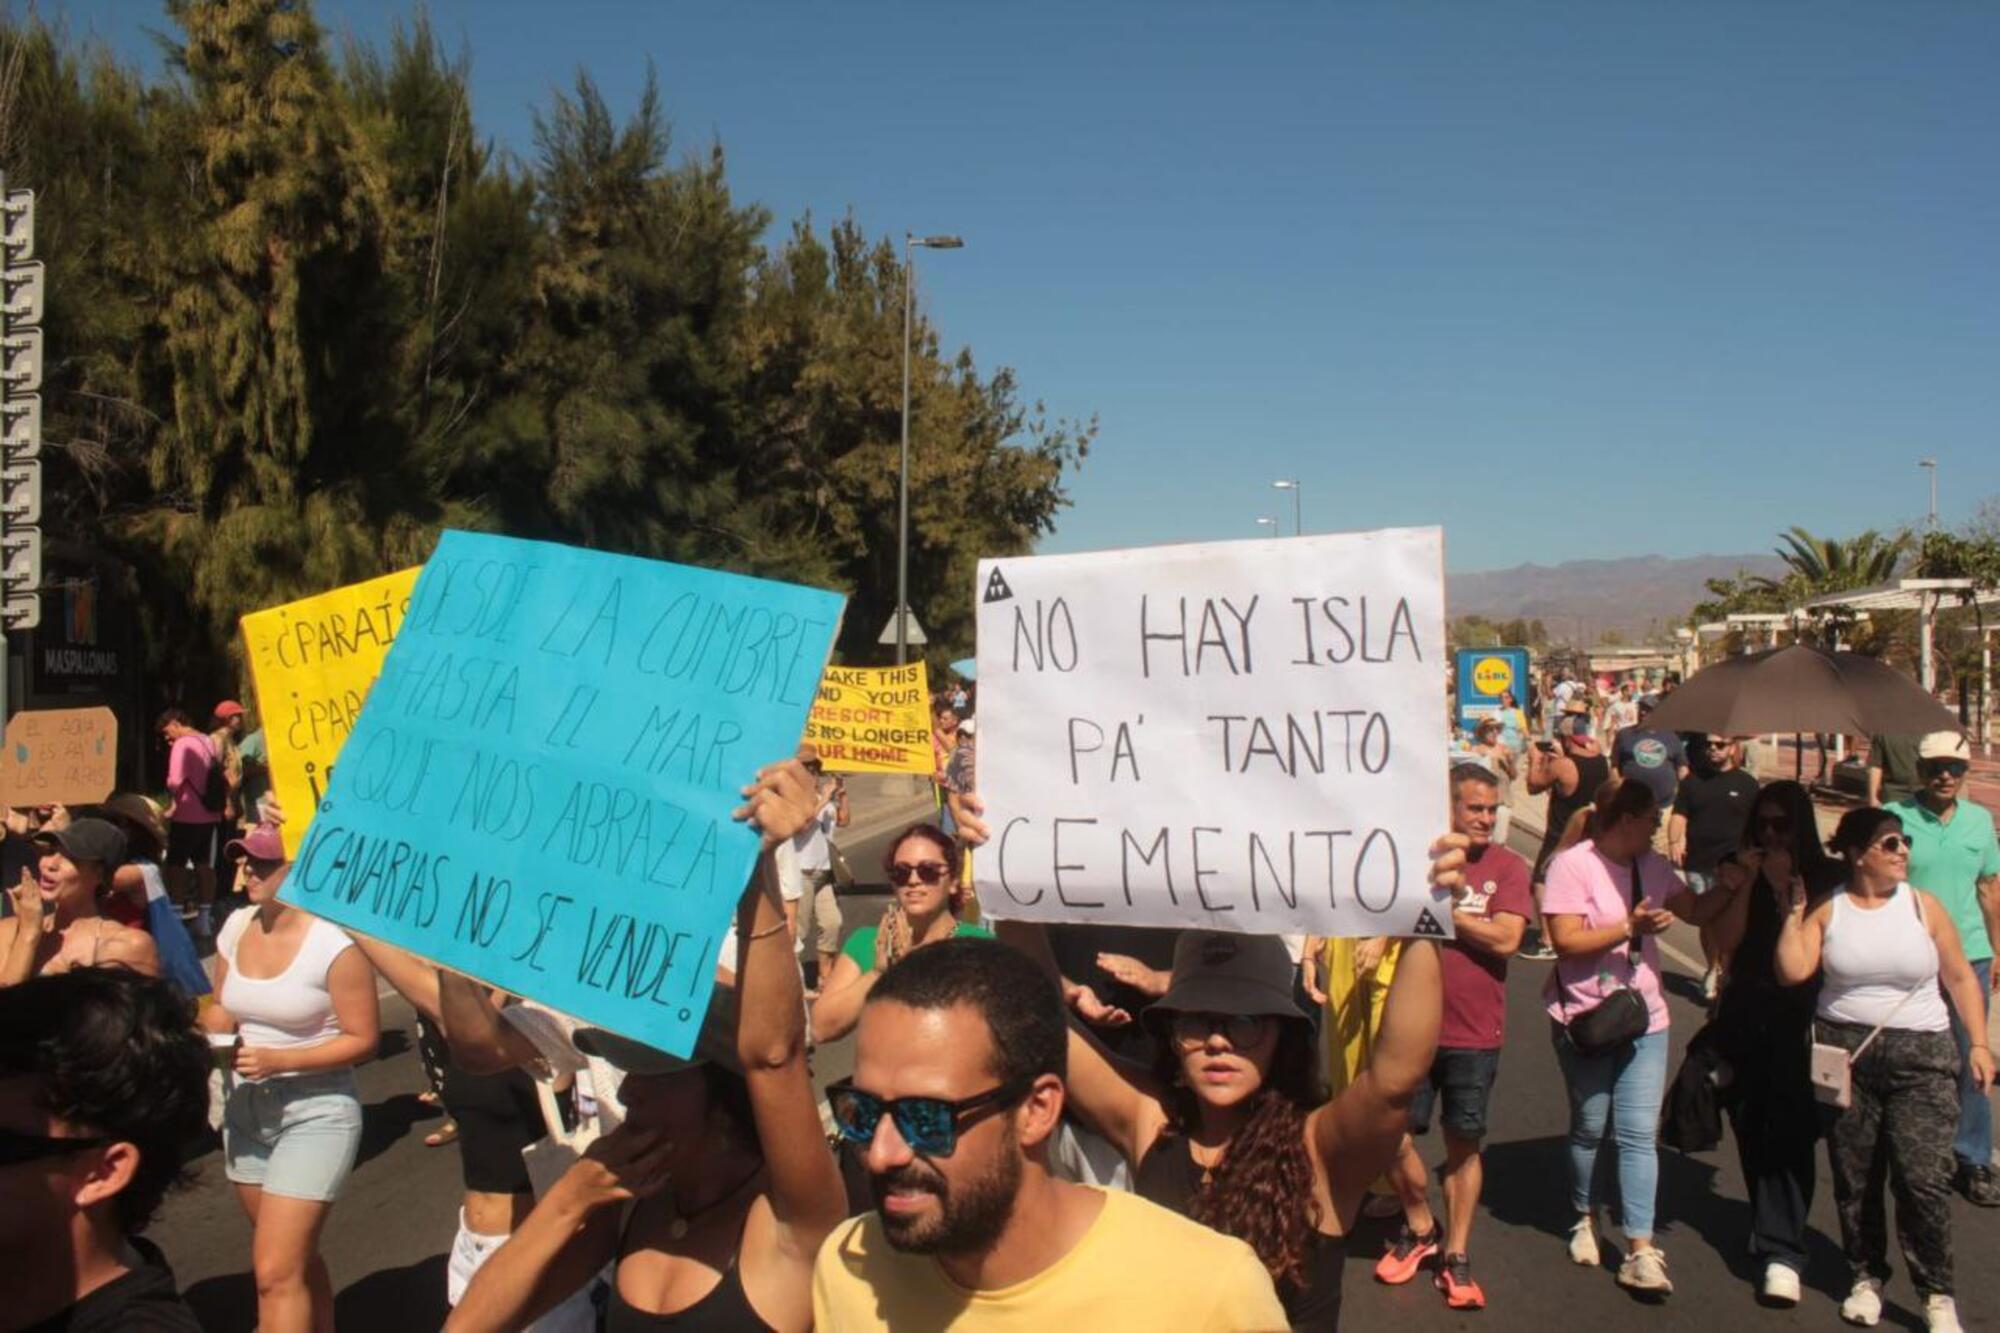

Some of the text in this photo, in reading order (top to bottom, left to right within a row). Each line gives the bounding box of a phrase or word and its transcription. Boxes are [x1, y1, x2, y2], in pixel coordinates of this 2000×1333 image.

[44, 649, 118, 675] MASPALOMAS
[409, 559, 827, 706] DESDE LA CUMBRE
[1012, 594, 1423, 678] NO HAY ISLA
[818, 687, 920, 707] ND YOUR
[877, 667, 918, 686] THIS
[288, 691, 363, 751] ¿PAR
[393, 650, 743, 790] HASTA EL MAR
[812, 706, 894, 724] RESORT
[820, 725, 846, 740] NO
[852, 728, 930, 745] LONGER
[1206, 710, 1391, 778] TANTO
[817, 742, 909, 763] UR HOME
[352, 727, 444, 816] QUE
[448, 751, 542, 842] NOS
[541, 781, 719, 895] ABRAZA
[998, 816, 1401, 914] CEMENTO
[453, 871, 513, 948] NO
[511, 892, 575, 972] SE
[576, 906, 713, 1022] VENDE!
